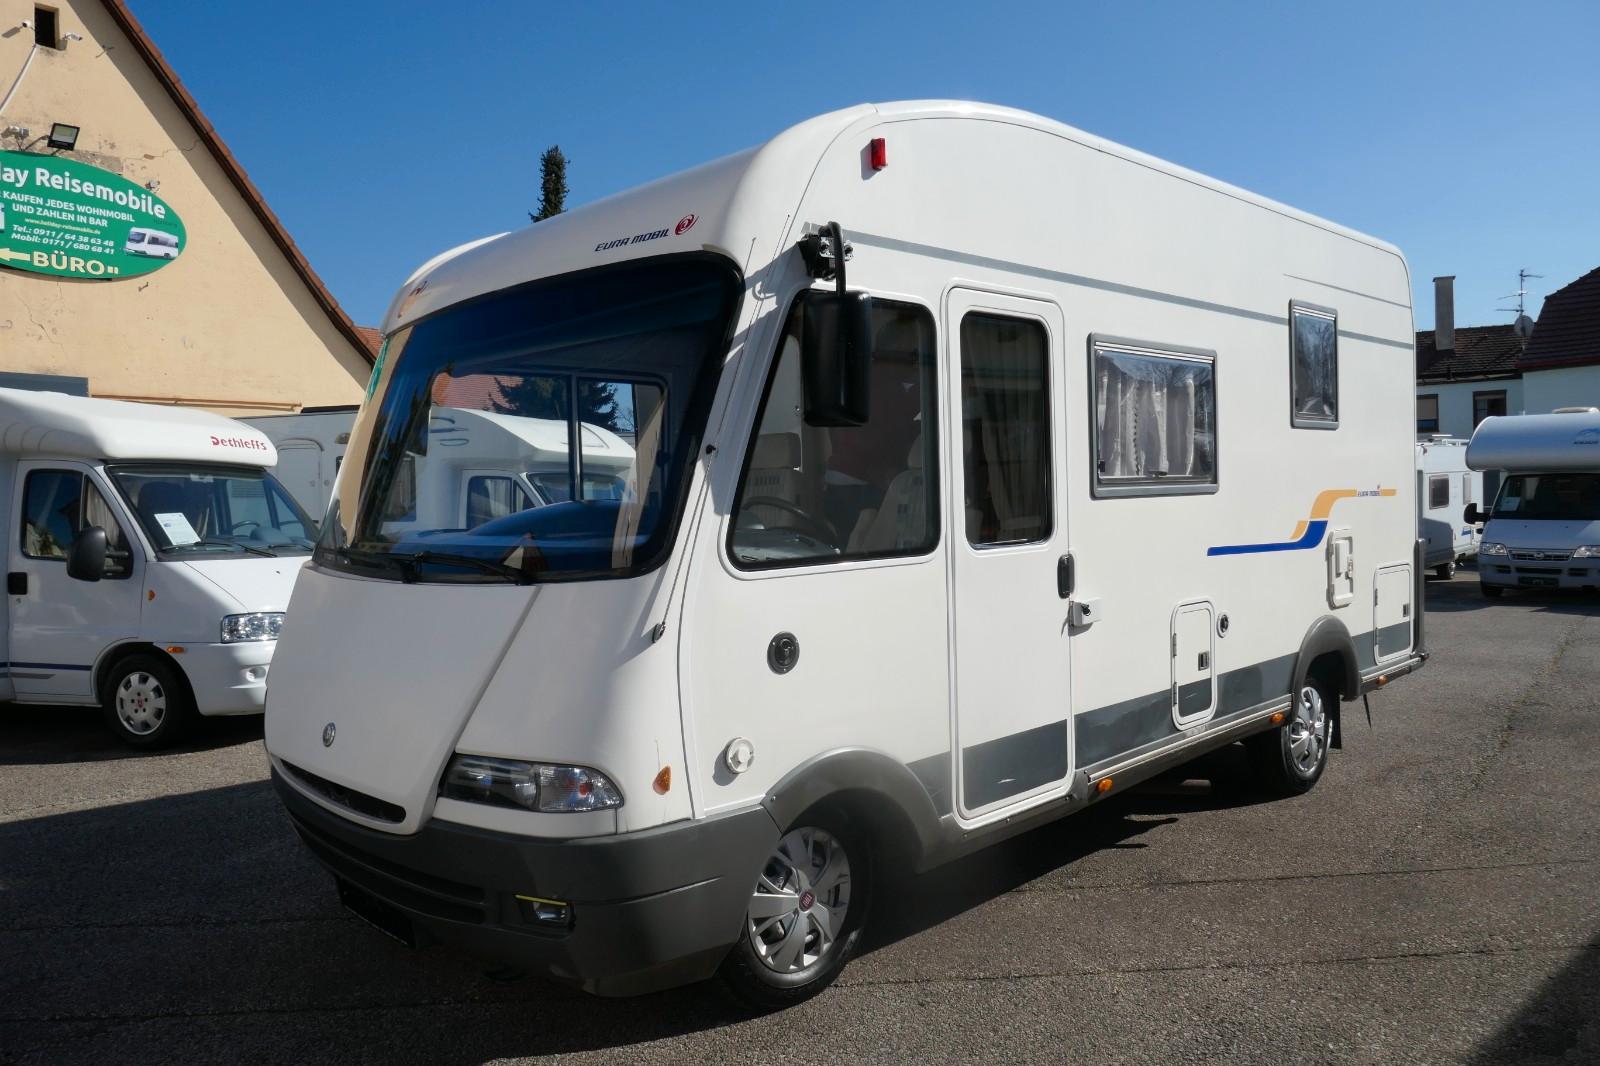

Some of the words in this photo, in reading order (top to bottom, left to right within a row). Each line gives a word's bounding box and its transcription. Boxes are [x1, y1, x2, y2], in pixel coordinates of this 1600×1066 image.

[0, 165, 29, 188] ay
[35, 167, 166, 219] Reisemobile
[3, 191, 43, 205] KAUFEN
[45, 198, 74, 211] JEDES
[76, 204, 135, 223] WOHNMOBIL
[12, 202, 34, 214] UND
[36, 207, 75, 222] ZAHLEN
[77, 214, 87, 223] IN
[89, 216, 108, 227] BAR
[11, 232, 40, 243] Mobil:
[42, 238, 65, 247] 0171
[33, 228, 55, 237] 0911
[64, 233, 76, 241] 64
[631, 228, 670, 244] MOBIL
[33, 250, 105, 275] BÜRO
[210, 435, 268, 451] Dethleffs
